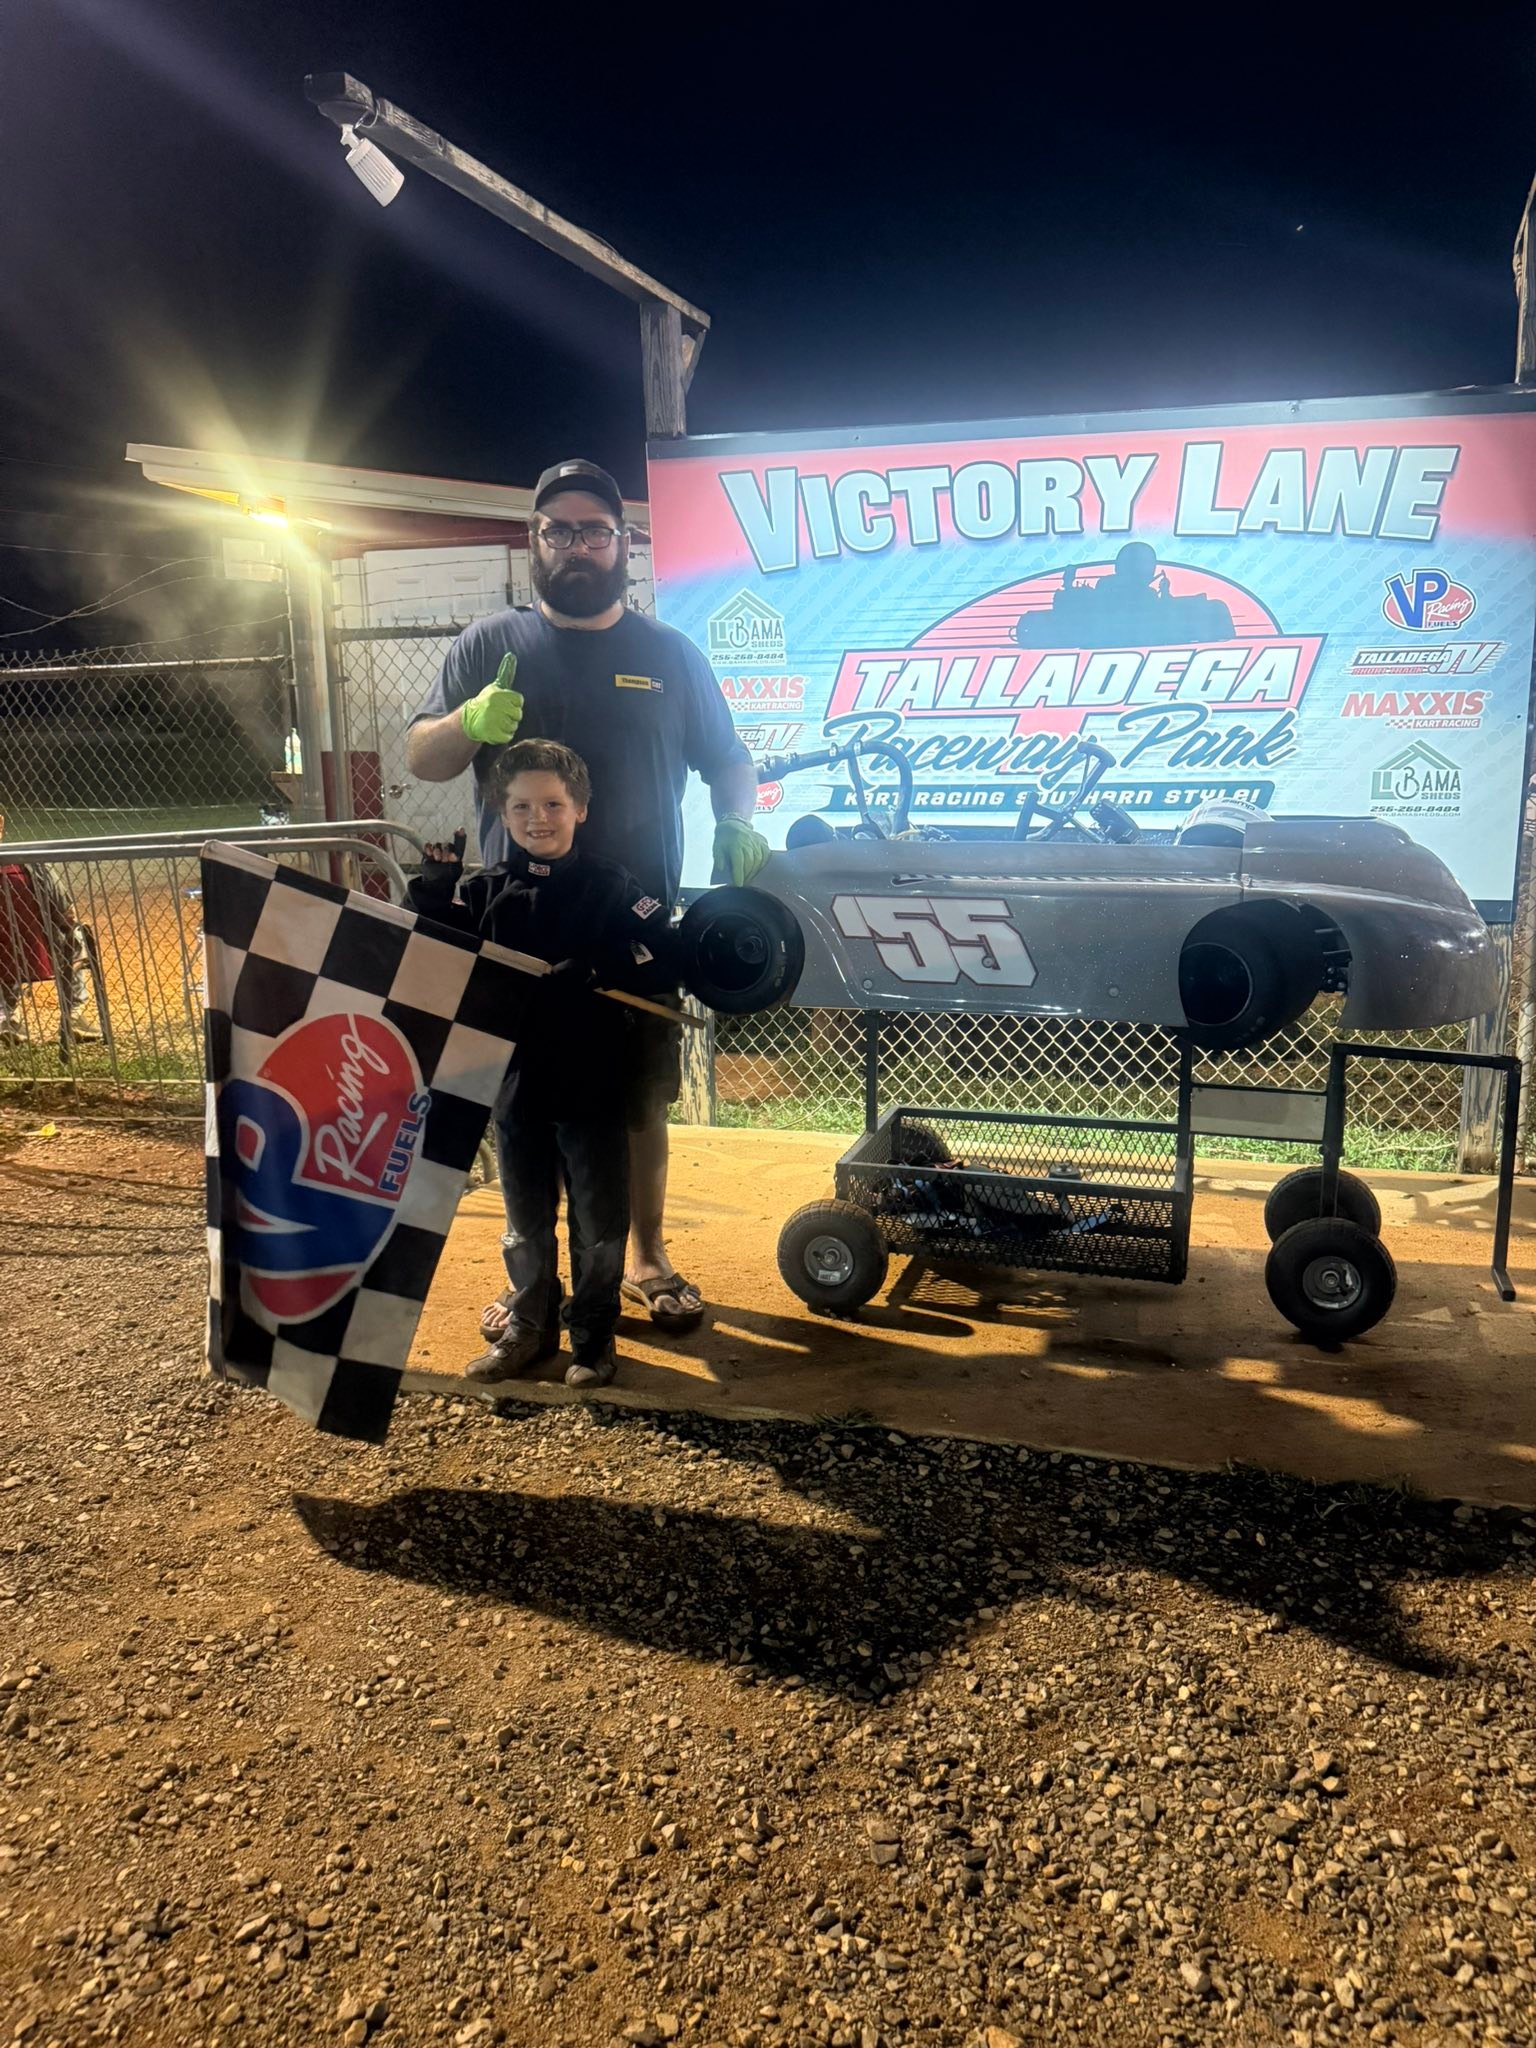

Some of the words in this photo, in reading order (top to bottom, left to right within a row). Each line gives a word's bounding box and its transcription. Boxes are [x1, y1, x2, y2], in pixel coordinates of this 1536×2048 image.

[719, 453, 1158, 575] VICTORY
[1174, 441, 1461, 541] LANE
[1390, 572, 1448, 628] VP
[1427, 598, 1472, 621] Racing
[751, 640, 784, 648] SHEDS
[722, 676, 804, 699] AXXIS
[853, 645, 1301, 711] TALLADEGA
[751, 702, 771, 711] KART
[772, 702, 801, 711] RACING
[1341, 691, 1485, 717] MAXXIS
[1415, 719, 1440, 728] KART
[1442, 719, 1479, 728] RACING
[823, 711, 1097, 790] Raceway
[1117, 704, 1296, 769] Park
[914, 791, 1005, 806] RACING
[1421, 792, 1461, 800] SHEDS
[315, 1012, 391, 1187] Racing
[379, 1092, 432, 1194] FUELS
